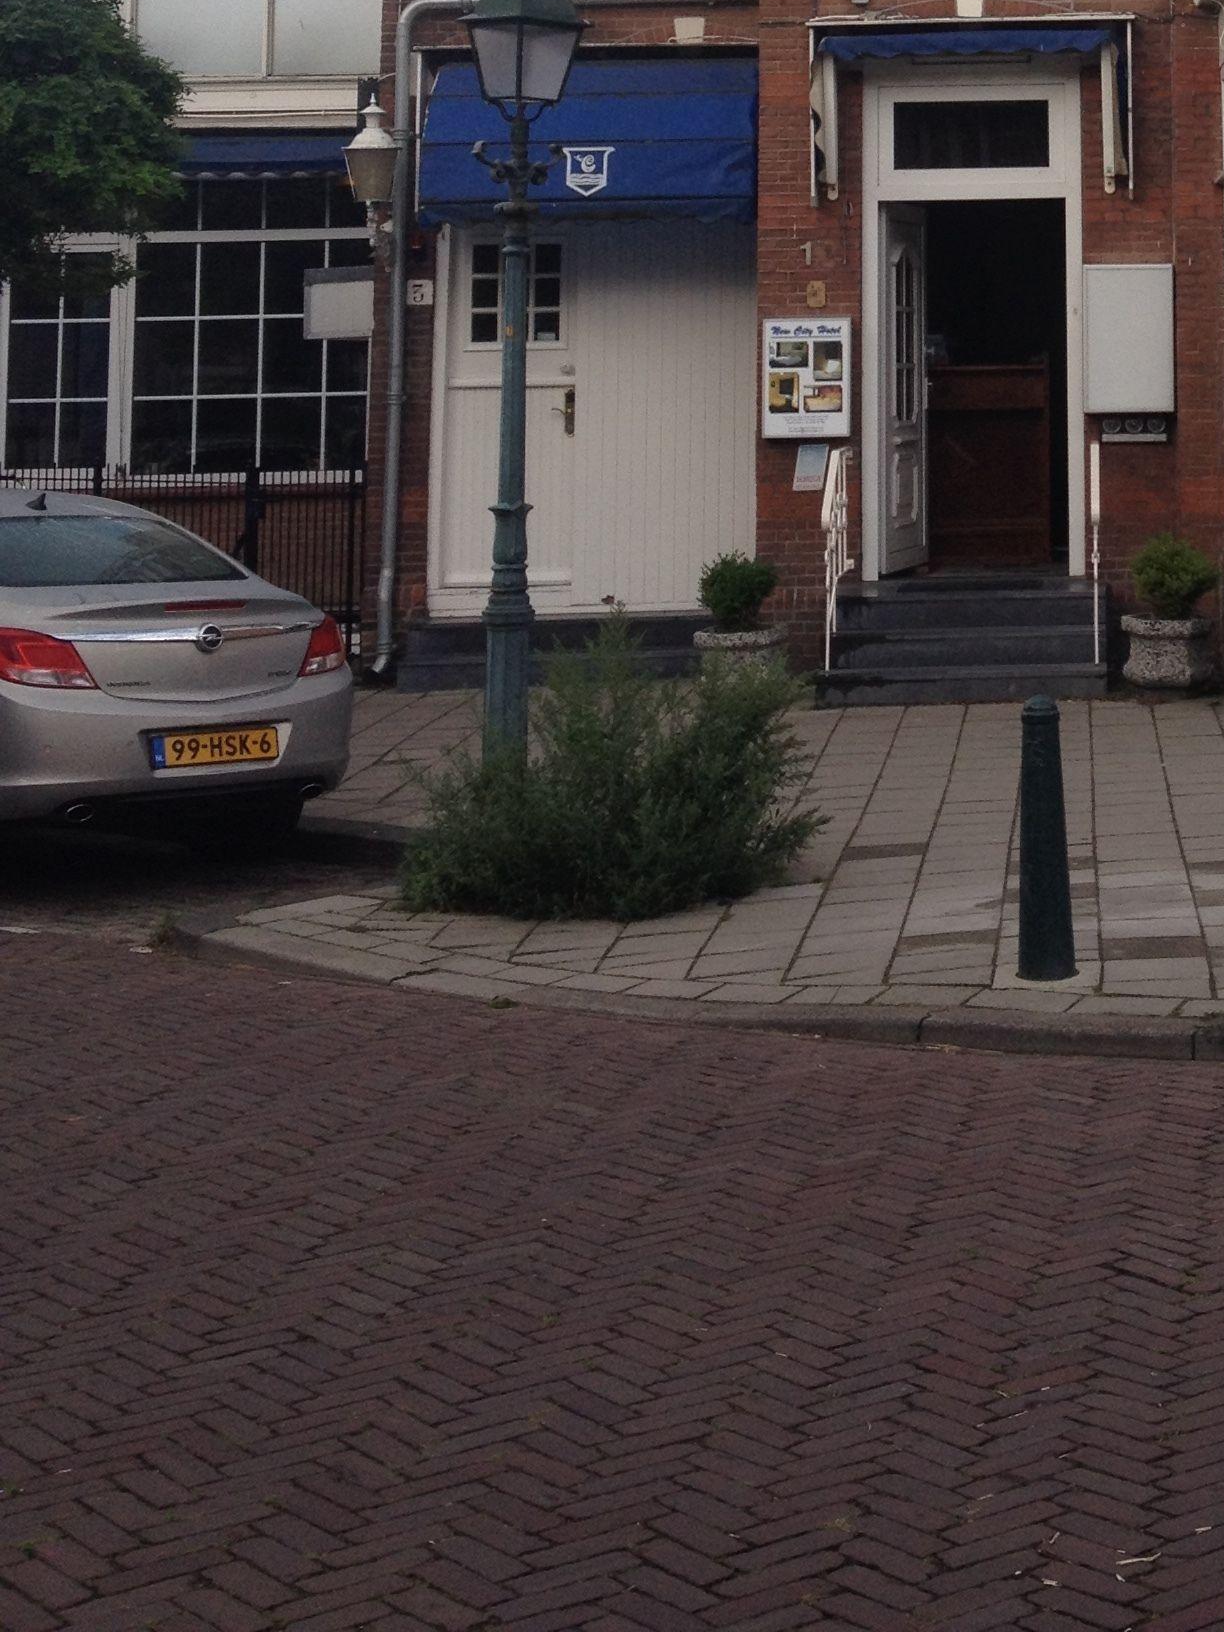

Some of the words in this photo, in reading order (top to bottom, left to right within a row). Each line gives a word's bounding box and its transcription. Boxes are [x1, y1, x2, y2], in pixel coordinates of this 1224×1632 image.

[800, 241, 812, 265] 1
[770, 325, 791, 336] New
[793, 324, 814, 337] City
[816, 324, 842, 335] Hotel
[171, 732, 272, 761] 99-HSK-6
